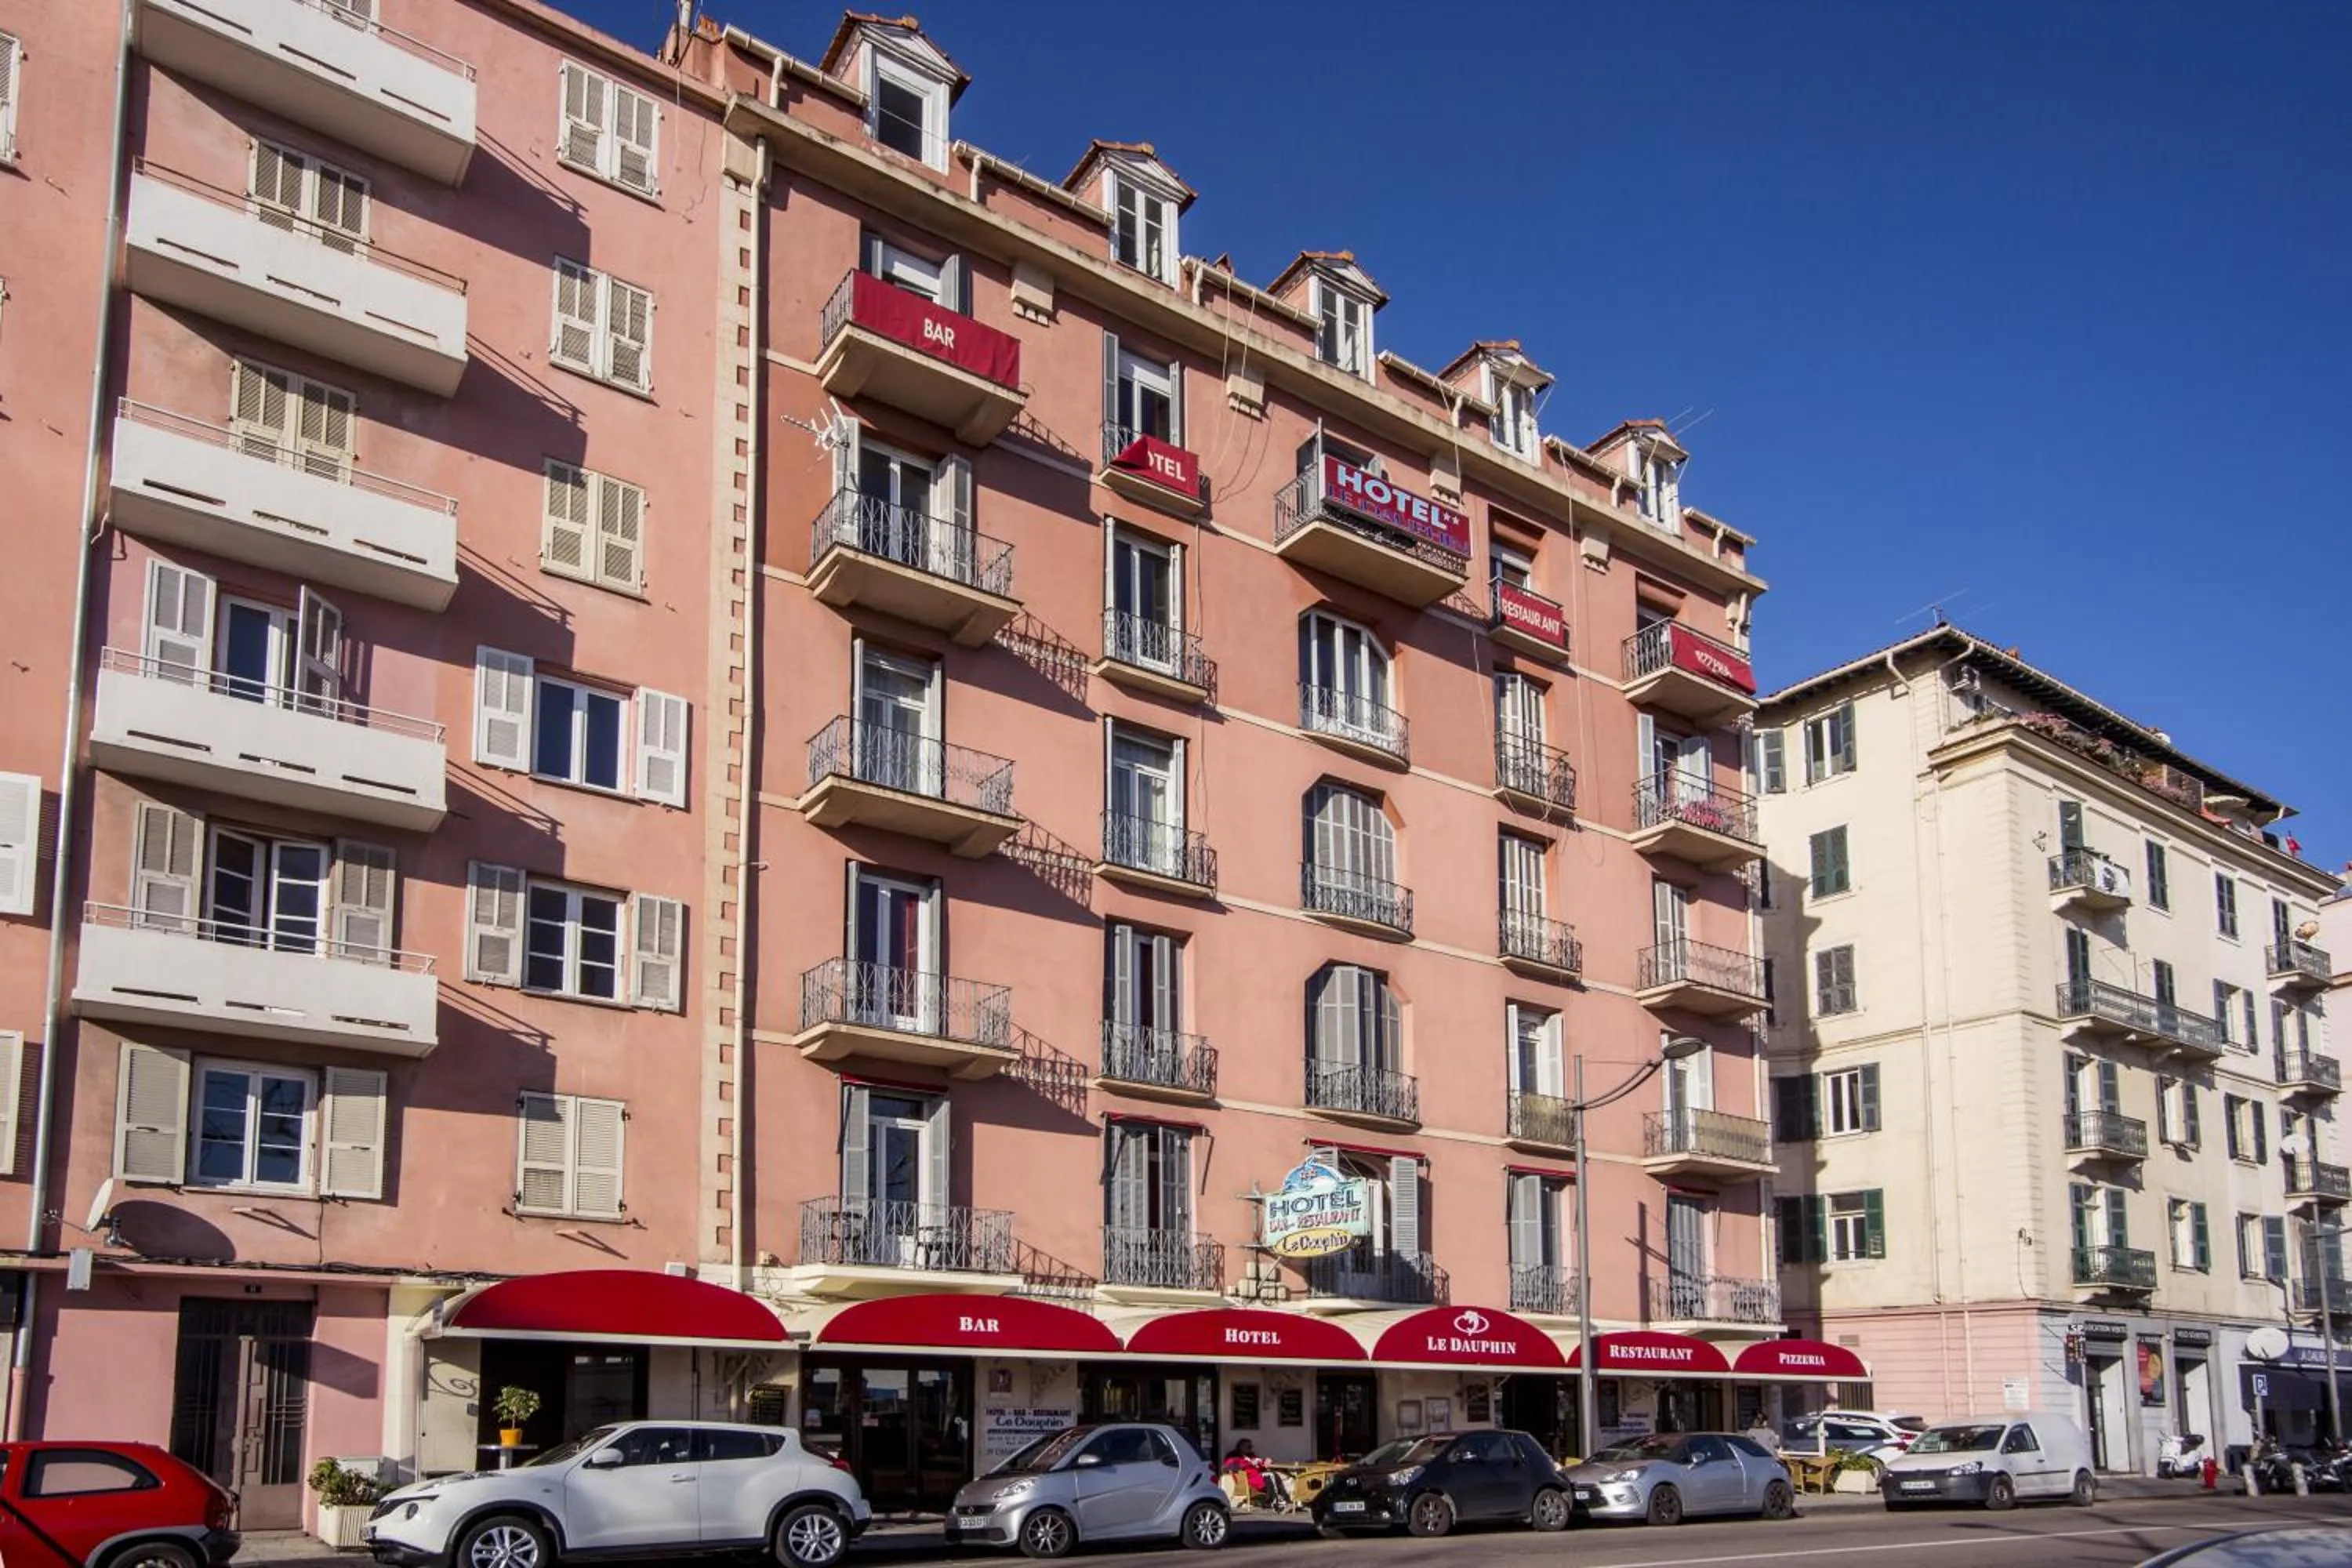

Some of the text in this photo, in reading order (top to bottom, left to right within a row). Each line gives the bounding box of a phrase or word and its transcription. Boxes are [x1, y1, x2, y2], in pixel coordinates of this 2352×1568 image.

[924, 318, 954, 349] BAR
[1501, 598, 1559, 636] RESTAURANT
[1269, 1189, 1361, 1218] HOTEL
[1283, 1232, 1348, 1251] Le Dauphin
[960, 1317, 1000, 1332] BAR
[1225, 1328, 1281, 1345] HOTEL
[1428, 1336, 1516, 1354] LE DAUPHIN
[1610, 1345, 1693, 1360] RESTAURANT
[1779, 1352, 1825, 1366] PIZZERIA
[996, 1417, 1065, 1429] Le Dauphin
